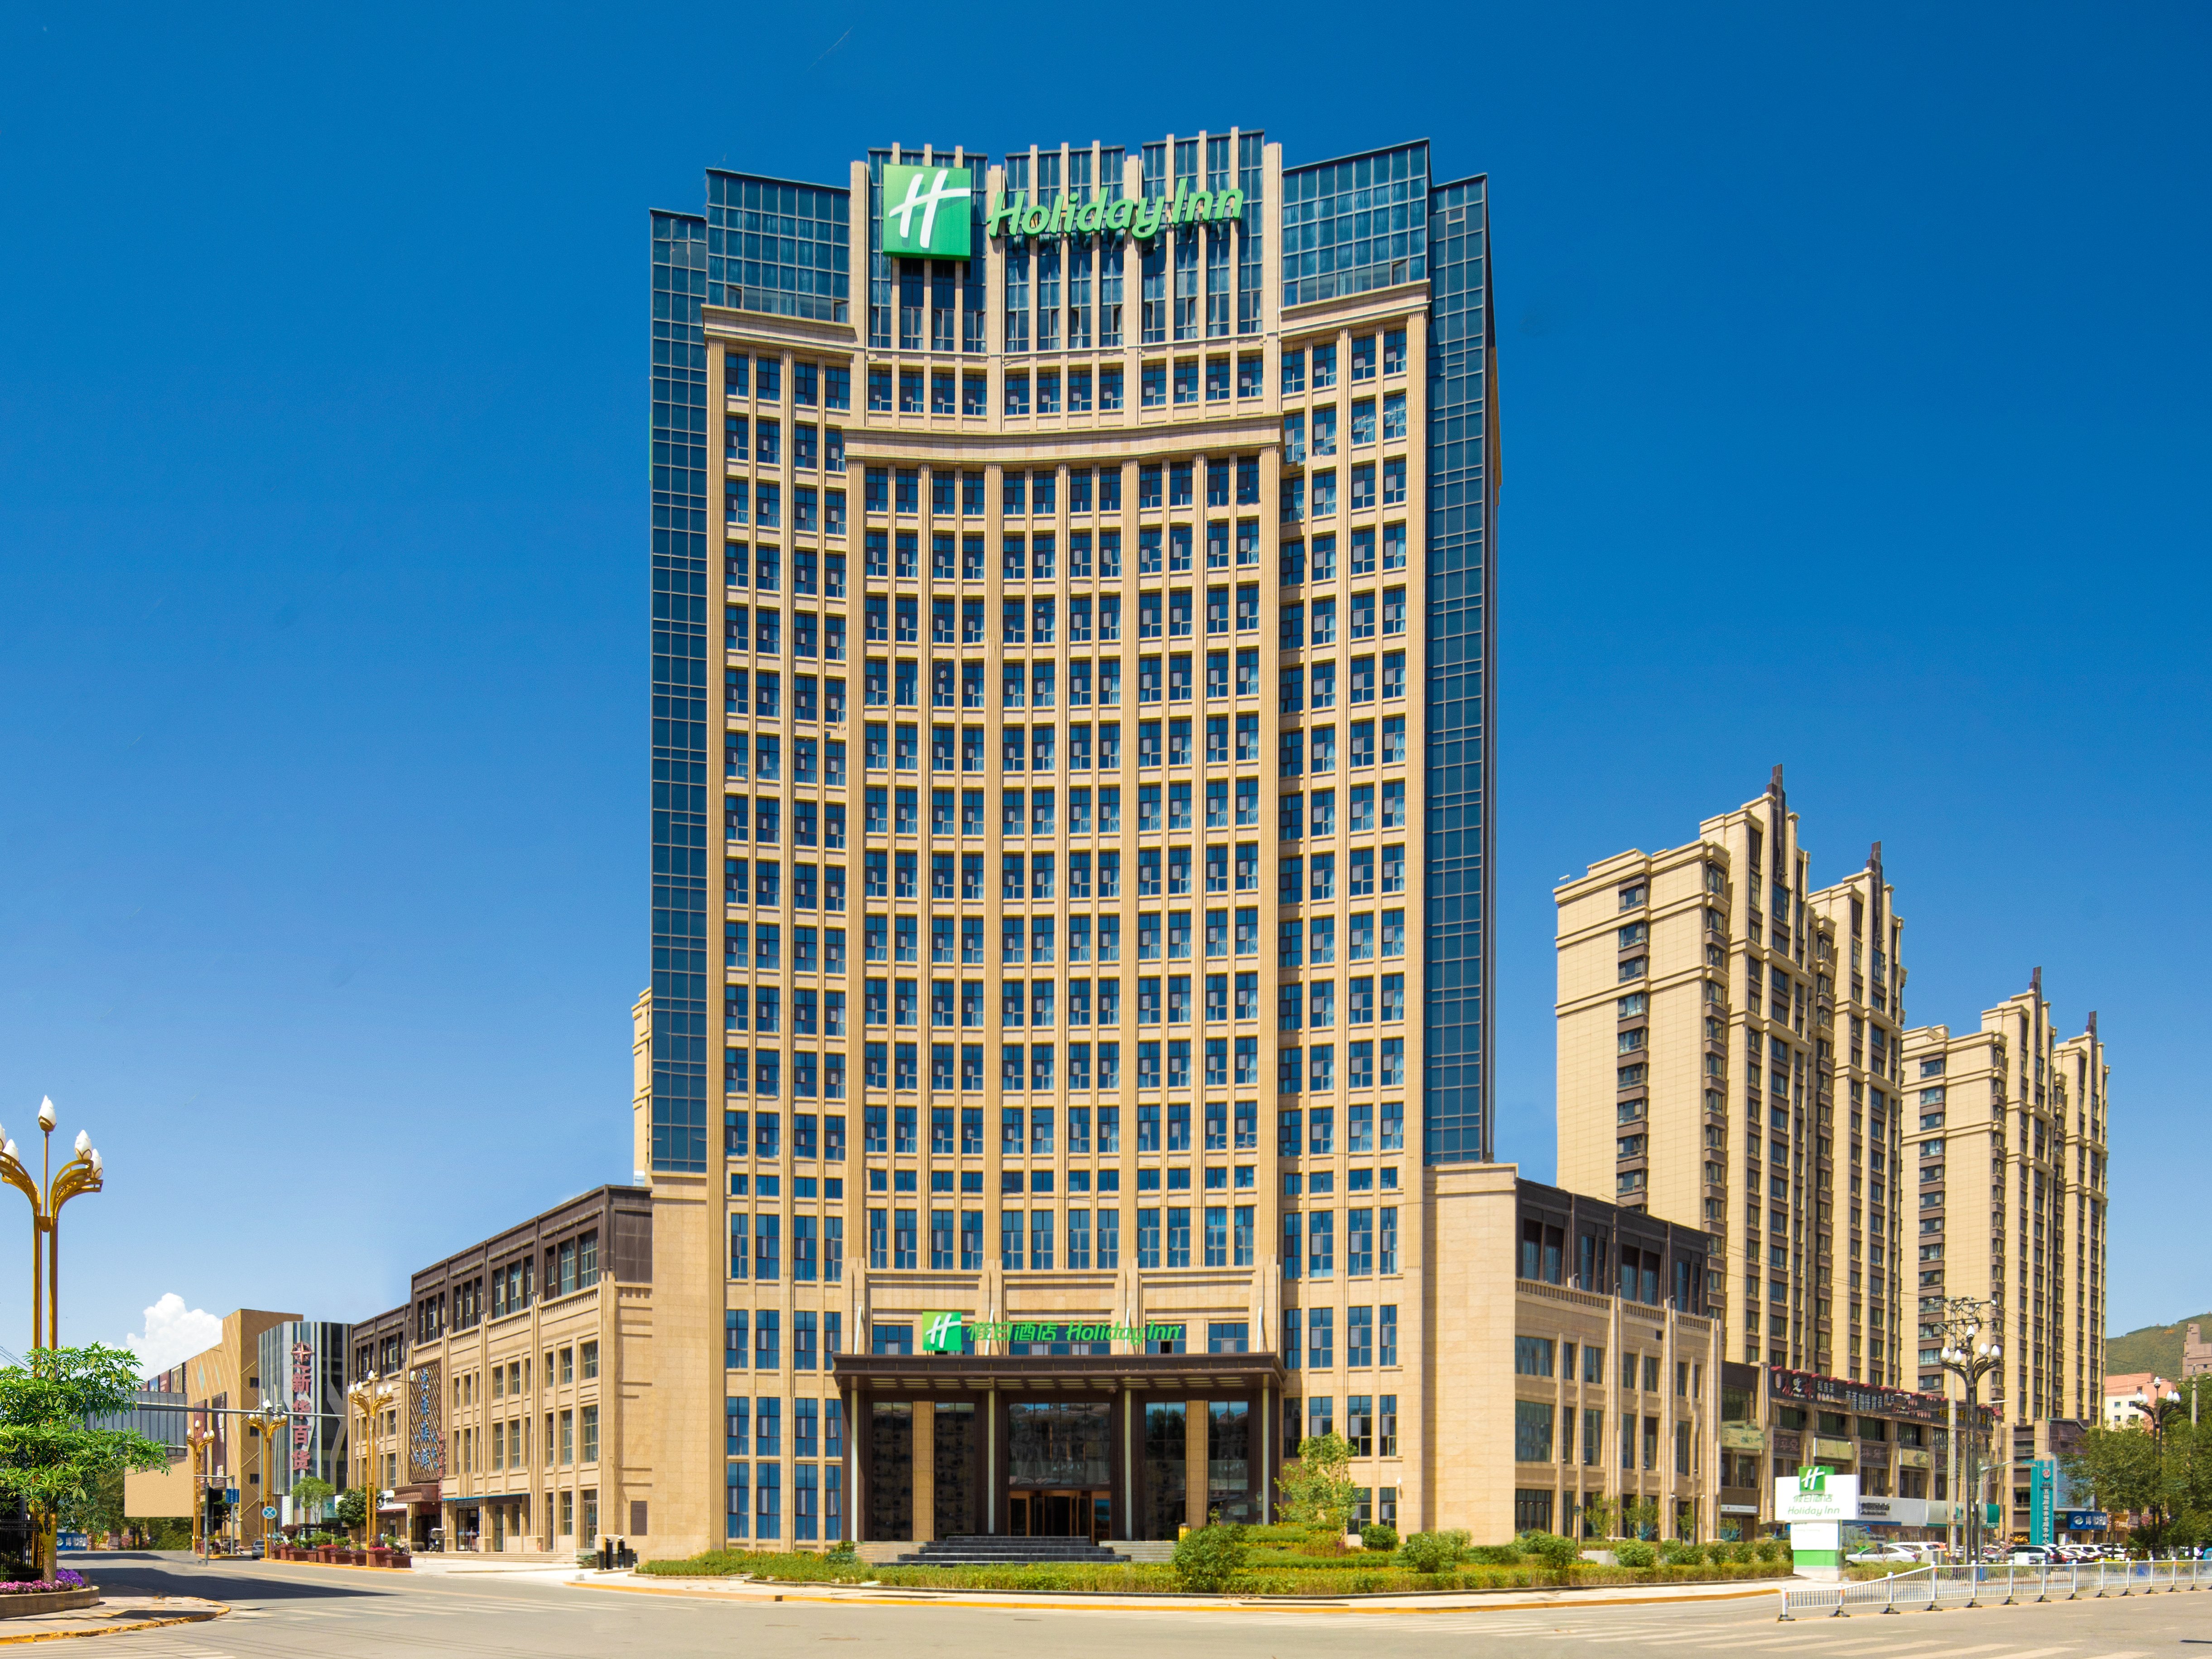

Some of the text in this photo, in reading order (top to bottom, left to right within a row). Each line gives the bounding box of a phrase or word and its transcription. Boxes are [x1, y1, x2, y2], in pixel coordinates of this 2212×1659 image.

[988, 178, 1244, 241] Holiday Inn
[967, 1320, 1180, 1346] 假日酒店 Holiday Inn
[291, 1364, 312, 1470] 新华百货
[1788, 1505, 1840, 1516] Holiday Inn
[1793, 1494, 1833, 1503] 假日酒店
